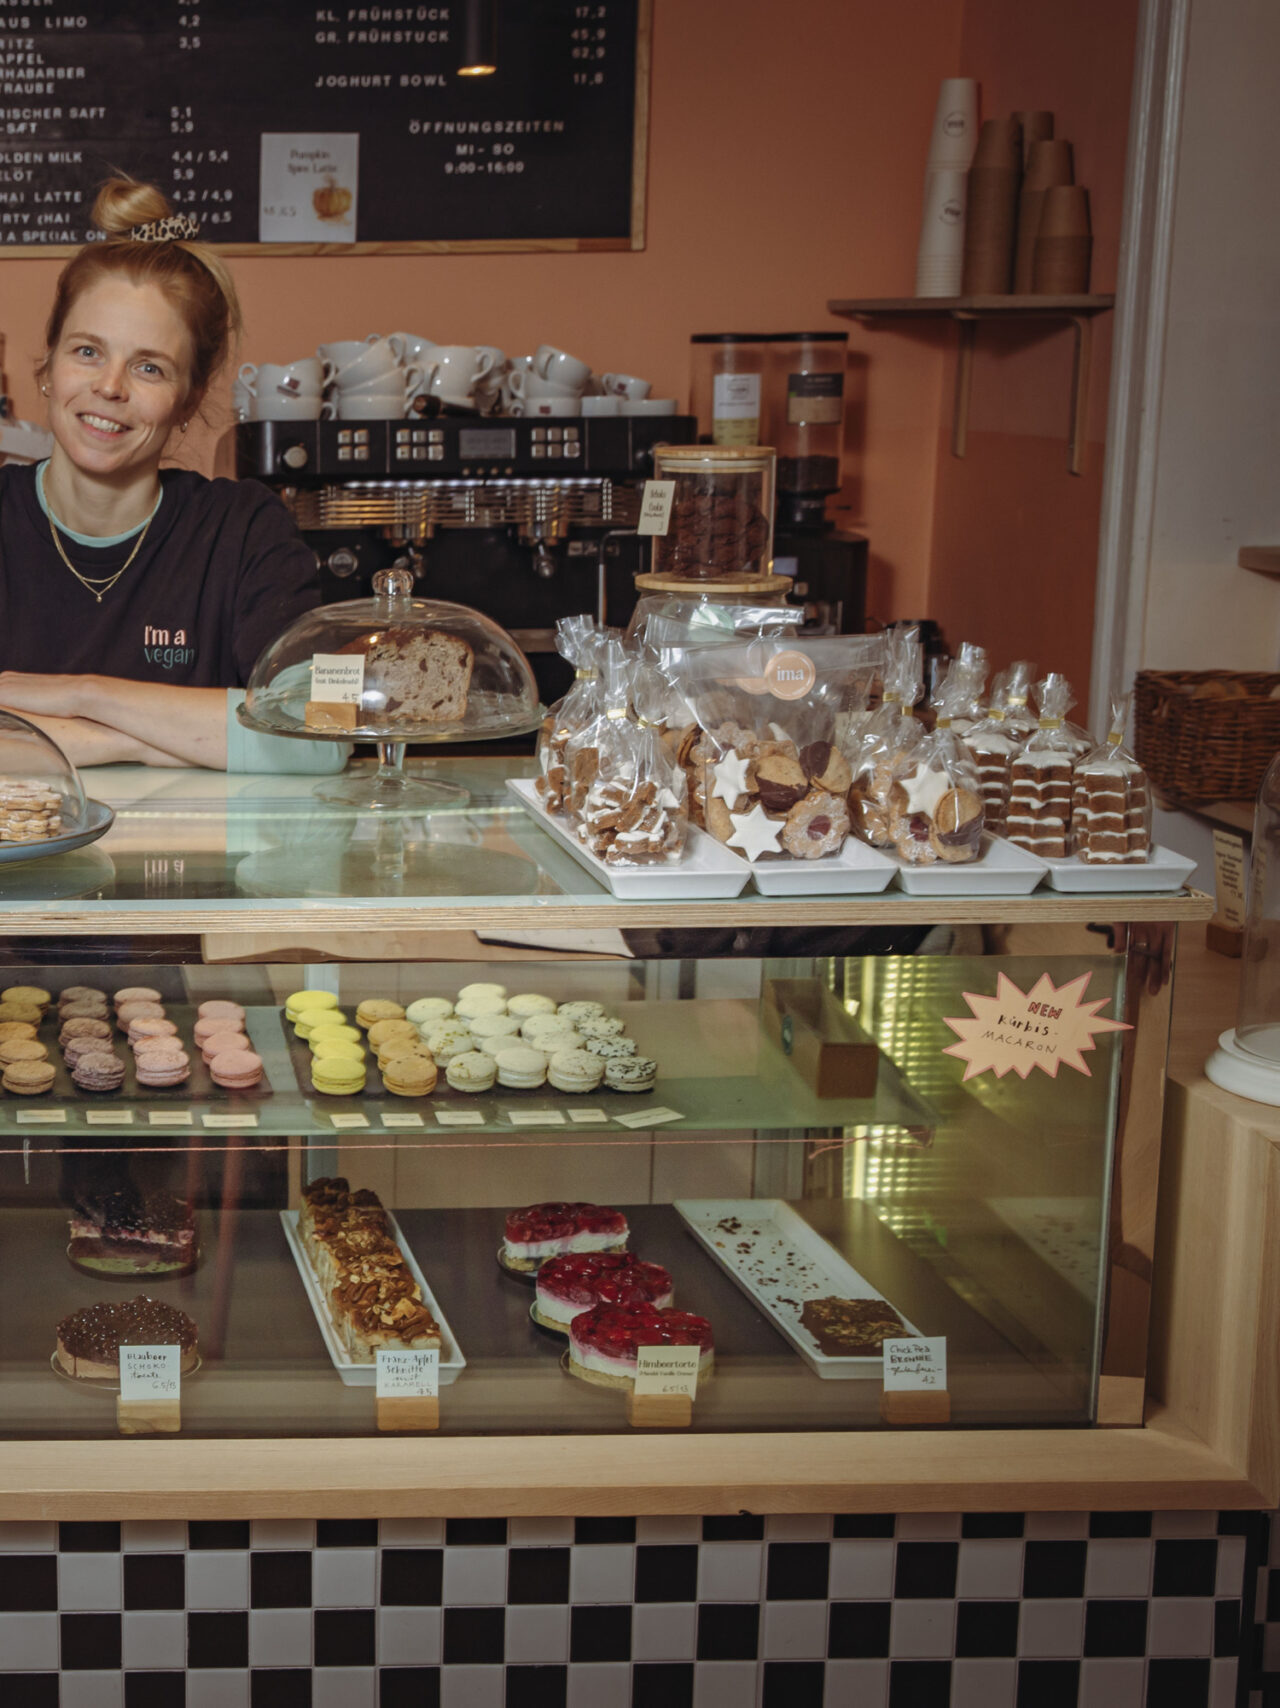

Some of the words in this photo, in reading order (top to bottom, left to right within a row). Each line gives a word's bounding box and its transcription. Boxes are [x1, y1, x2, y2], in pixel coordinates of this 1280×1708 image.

[348, 7, 450, 21] FRÜHSTÜCK
[45, 16, 87, 28] LIMO
[315, 75, 391, 88] JOGHURT
[400, 75, 447, 87] BOWL
[69, 107, 106, 119] SAFT
[409, 119, 565, 135] ÖFFNUNGSZEITEN
[492, 143, 514, 156] SO
[48, 151, 82, 163] MILK
[34, 191, 82, 203] LATTE
[6, 231, 17, 242] A
[22, 230, 78, 242] SPECIAL
[144, 625, 169, 646] I'm
[173, 629, 186, 646] a
[144, 647, 195, 669] vegan
[776, 665, 804, 681] ima
[1027, 1001, 1063, 1020] NEW
[981, 1031, 1058, 1054] MACARON
[638, 1359, 696, 1369] Himbeertorte
